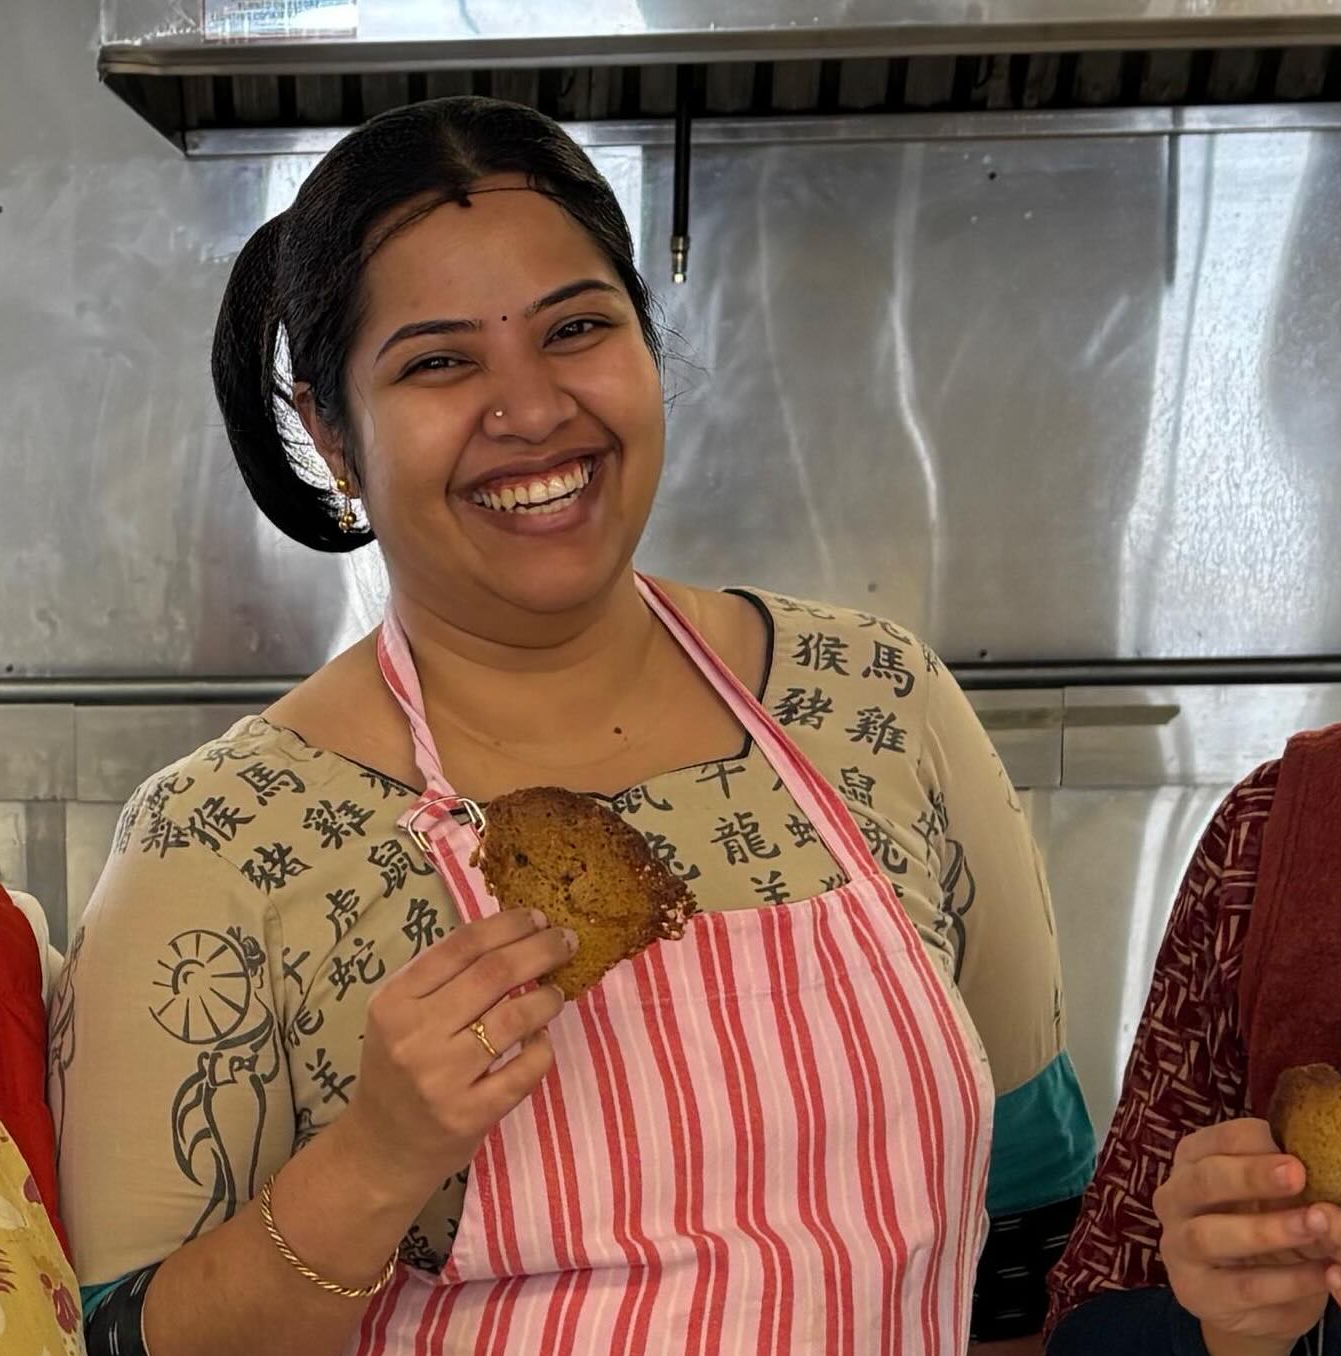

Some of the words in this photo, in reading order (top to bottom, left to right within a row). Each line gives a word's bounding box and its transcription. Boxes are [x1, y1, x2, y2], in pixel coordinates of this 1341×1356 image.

[792, 632, 850, 676] 猴
[862, 640, 915, 698] 馬
[845, 706, 908, 755] 雞
[236, 761, 306, 806] 馬
[184, 796, 257, 851] 猴
[710, 811, 782, 865] 龍
[367, 839, 435, 898] 鼠
[328, 937, 386, 1002] 蛇
[297, 1047, 357, 1104] 羊
